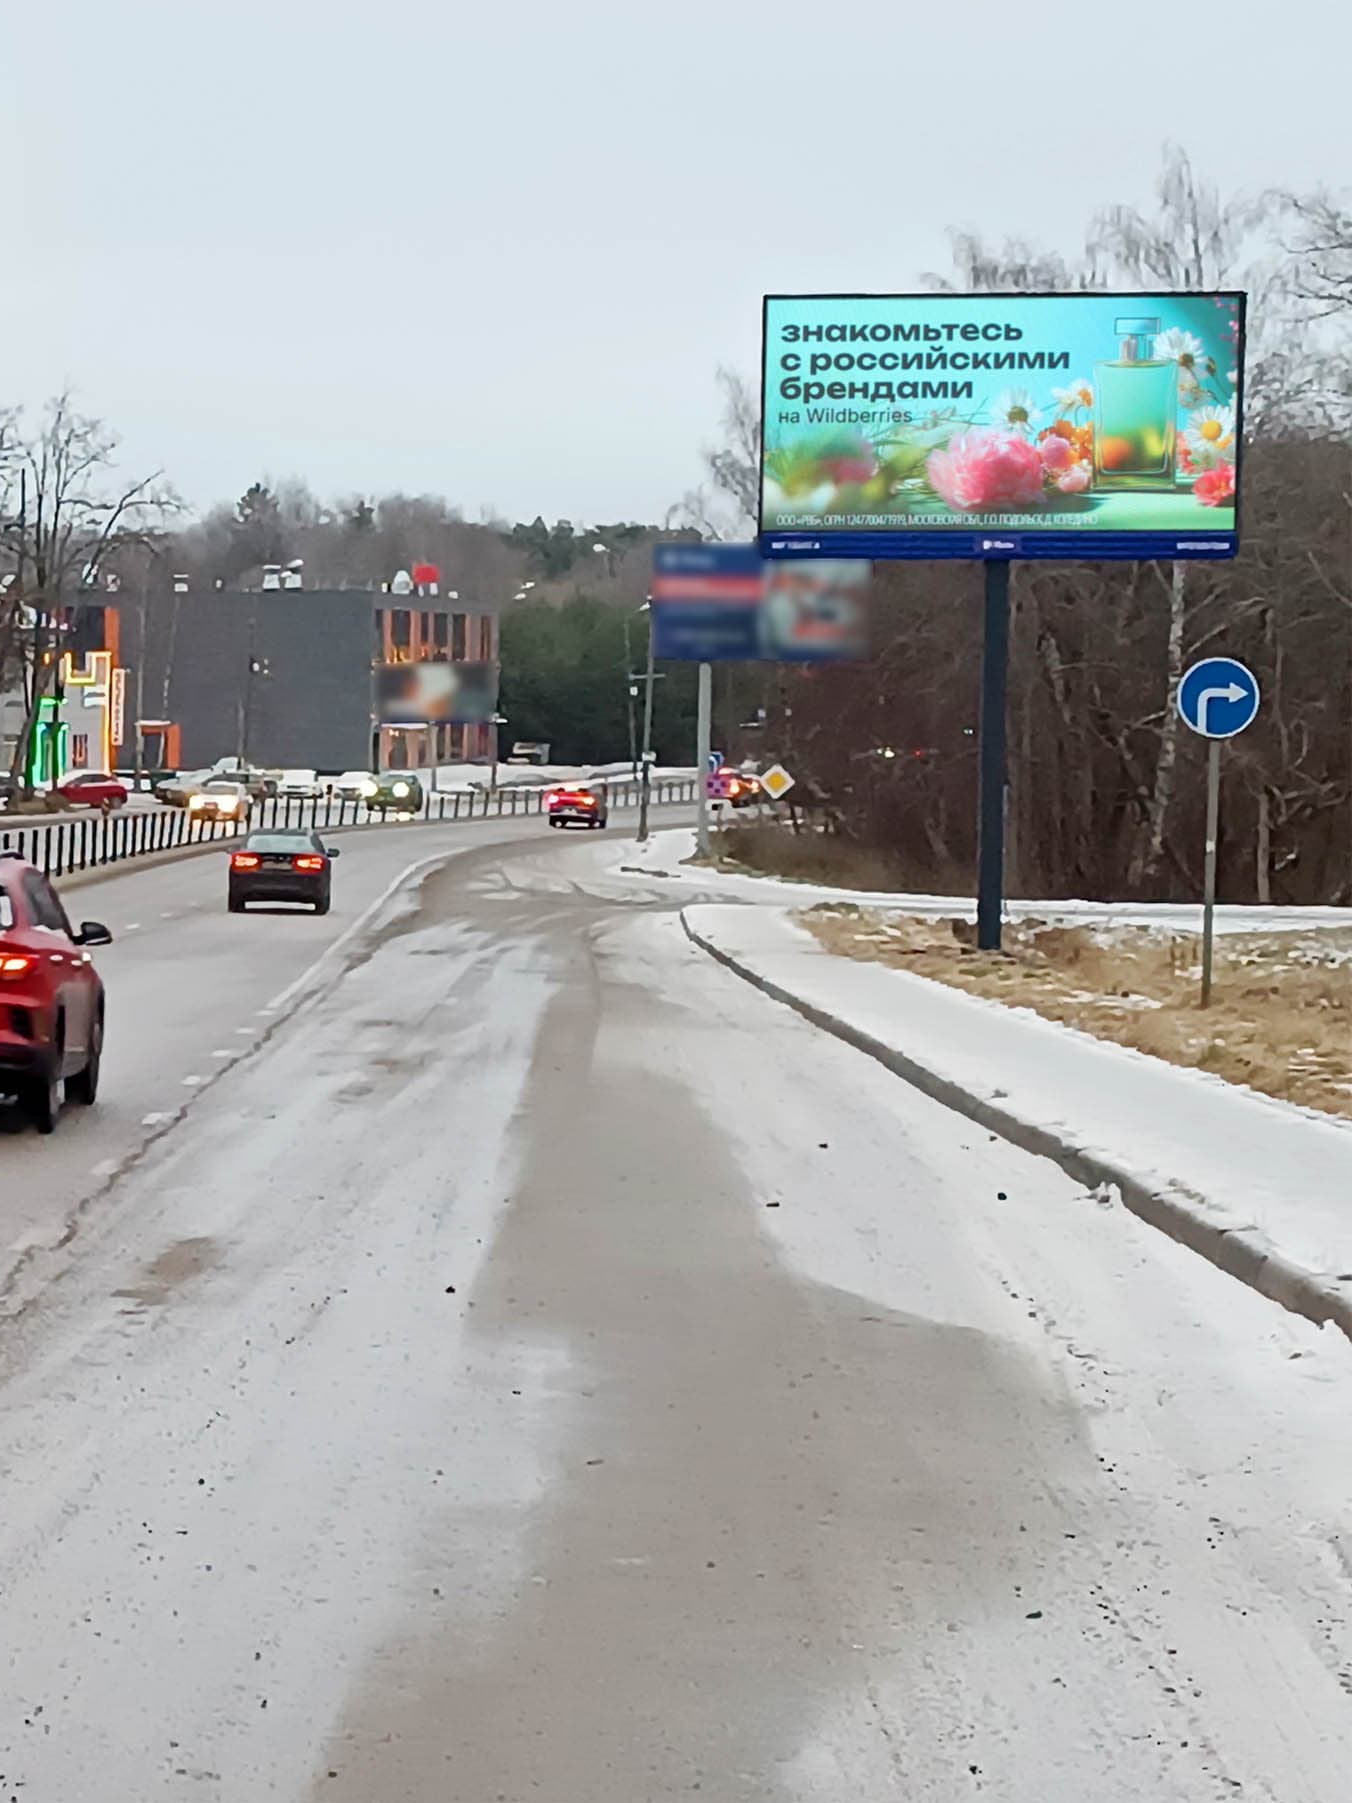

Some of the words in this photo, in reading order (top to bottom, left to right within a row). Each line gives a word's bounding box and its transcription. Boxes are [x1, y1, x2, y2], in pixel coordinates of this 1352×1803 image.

[781, 323, 1023, 343] знакомьтесь
[780, 352, 801, 372] с
[810, 346, 1070, 375] российскими
[779, 376, 973, 404] брендами
[778, 412, 800, 424] на
[807, 407, 913, 424] Wildberries
[776, 514, 796, 526] ООО
